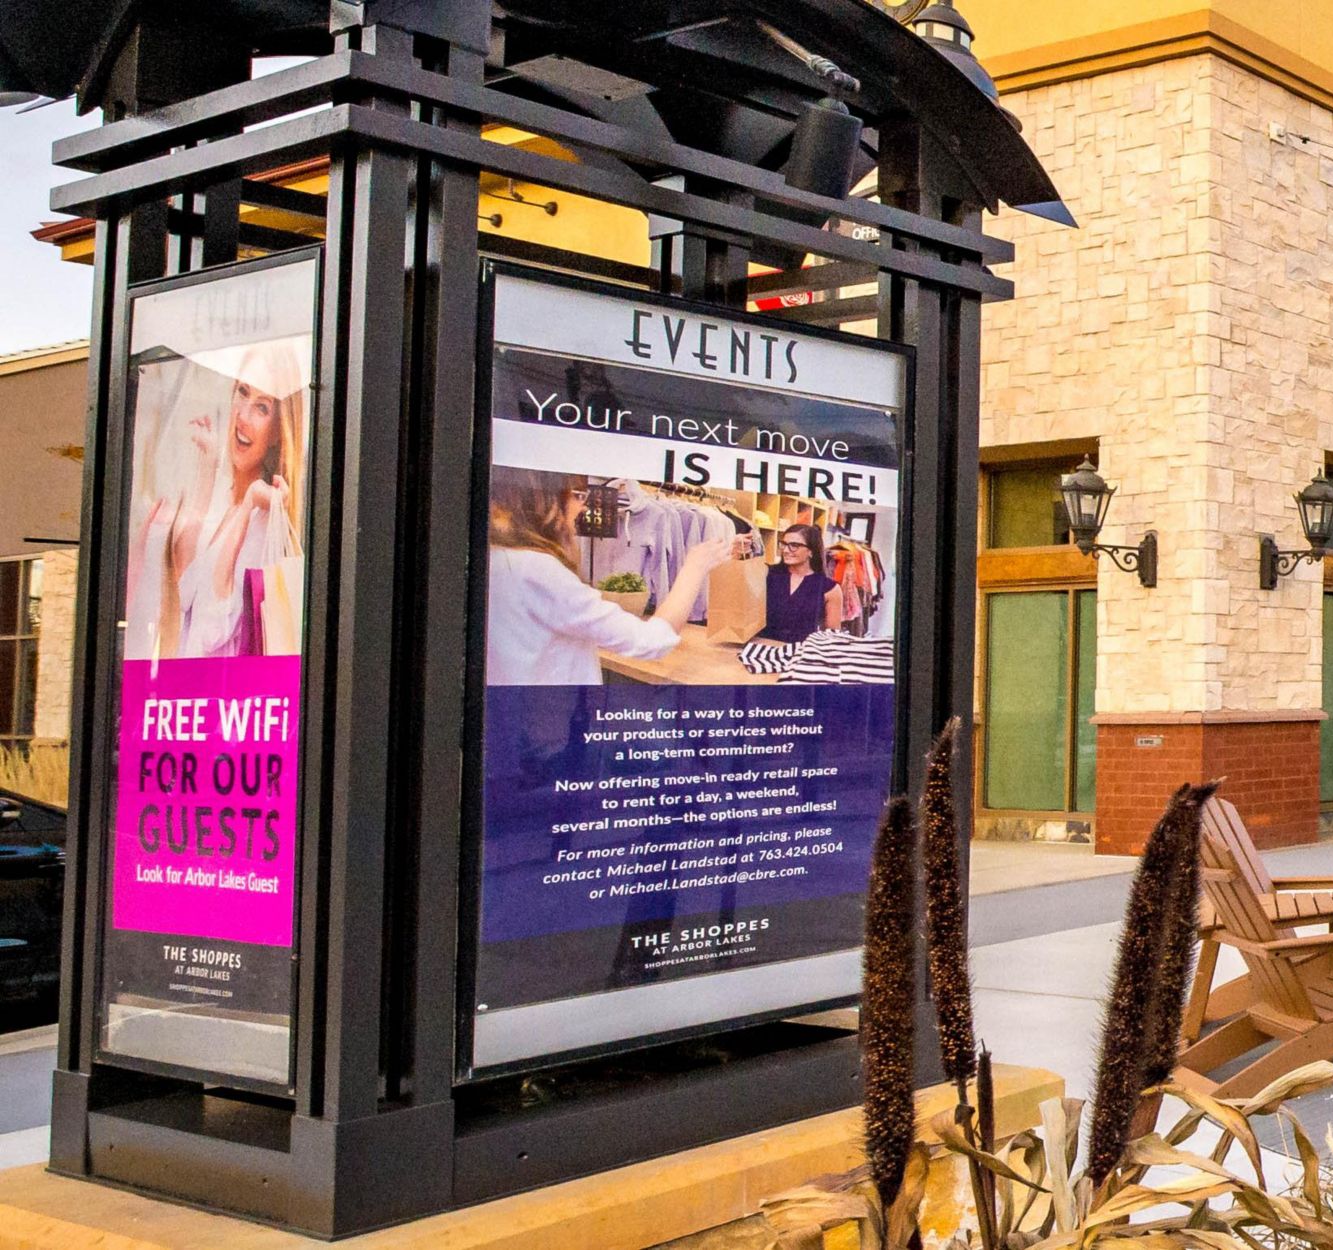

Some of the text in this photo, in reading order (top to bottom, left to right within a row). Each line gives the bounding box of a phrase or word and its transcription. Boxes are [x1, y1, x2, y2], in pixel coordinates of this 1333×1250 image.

[624, 309, 799, 384] EVENTS
[526, 389, 849, 460] Your next move
[664, 450, 877, 505] IS HERE!
[142, 697, 289, 742] FREE WiFi
[596, 707, 814, 721] Looking for a way to showcase
[584, 724, 823, 743] your products or services without
[615, 743, 794, 761] a long-term commitment?
[139, 752, 283, 797] FOR OUR
[555, 766, 838, 792] Now offering move-in ready retail space
[602, 786, 799, 809] to rent for a day, a weekend,
[138, 804, 280, 861] GUESTS
[552, 819, 608, 834] several
[710, 806, 758, 821] options
[762, 806, 782, 816] are
[786, 800, 837, 814] endless!
[557, 827, 832, 862] For more information and pricing, please
[136, 865, 278, 893] Look for Arbor Lakes Guest
[543, 842, 843, 885] contact Michael Landstad at 763.424.0504
[589, 866, 808, 900] or Michael.Landstad@cbre.com.
[632, 918, 770, 948] THE SHOPPES
[652, 934, 751, 956] AT ARBOR LAKES
[163, 946, 241, 968] THE SHOPPES
[175, 966, 230, 980] AT ARBOR LAKES
